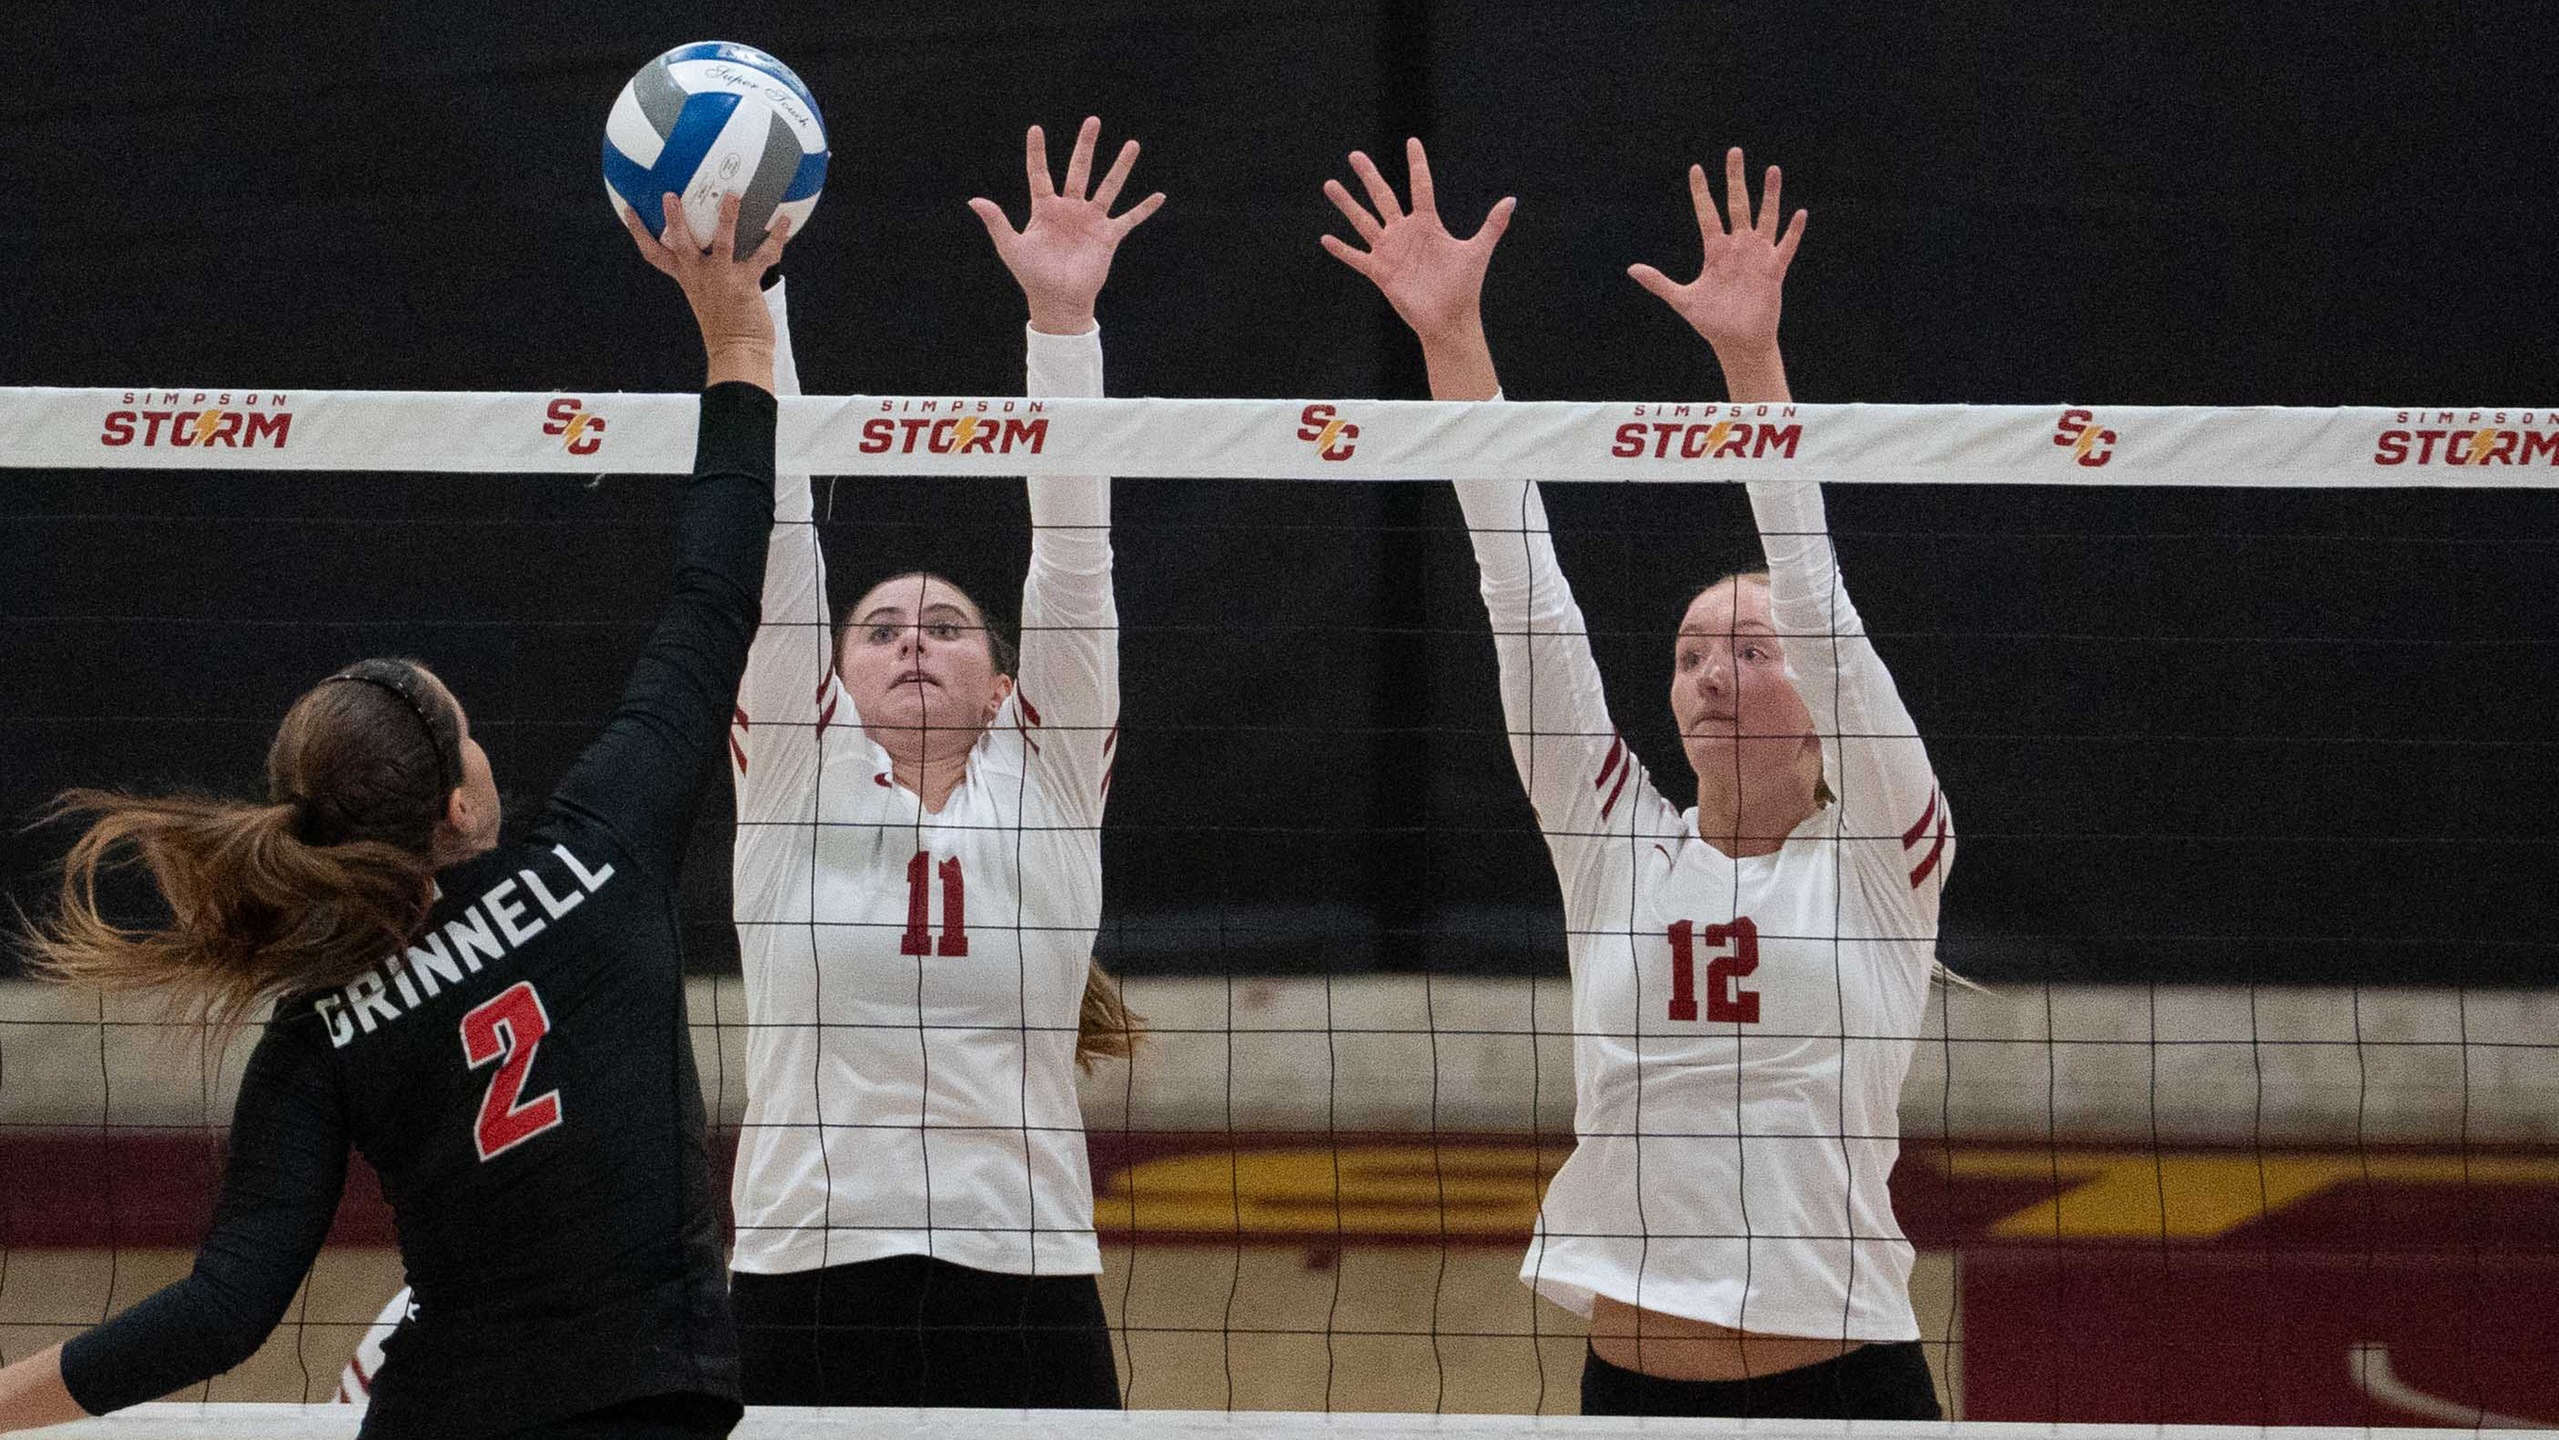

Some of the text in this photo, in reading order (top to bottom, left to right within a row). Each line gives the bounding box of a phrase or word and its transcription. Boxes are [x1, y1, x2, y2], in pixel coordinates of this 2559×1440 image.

[122, 392, 287, 406] SIMPSON
[881, 400, 1044, 413] SIMPSON
[1634, 405, 1797, 418] SIMPSON
[101, 409, 293, 449] STORM
[859, 416, 1050, 455] STORM
[1611, 421, 1803, 460] STORM
[2374, 428, 2559, 466] STORM
[901, 850, 968, 957] 11
[314, 844, 615, 1048] GRINNELL
[1668, 915, 1760, 1024] 12
[459, 980, 563, 1163] 2
